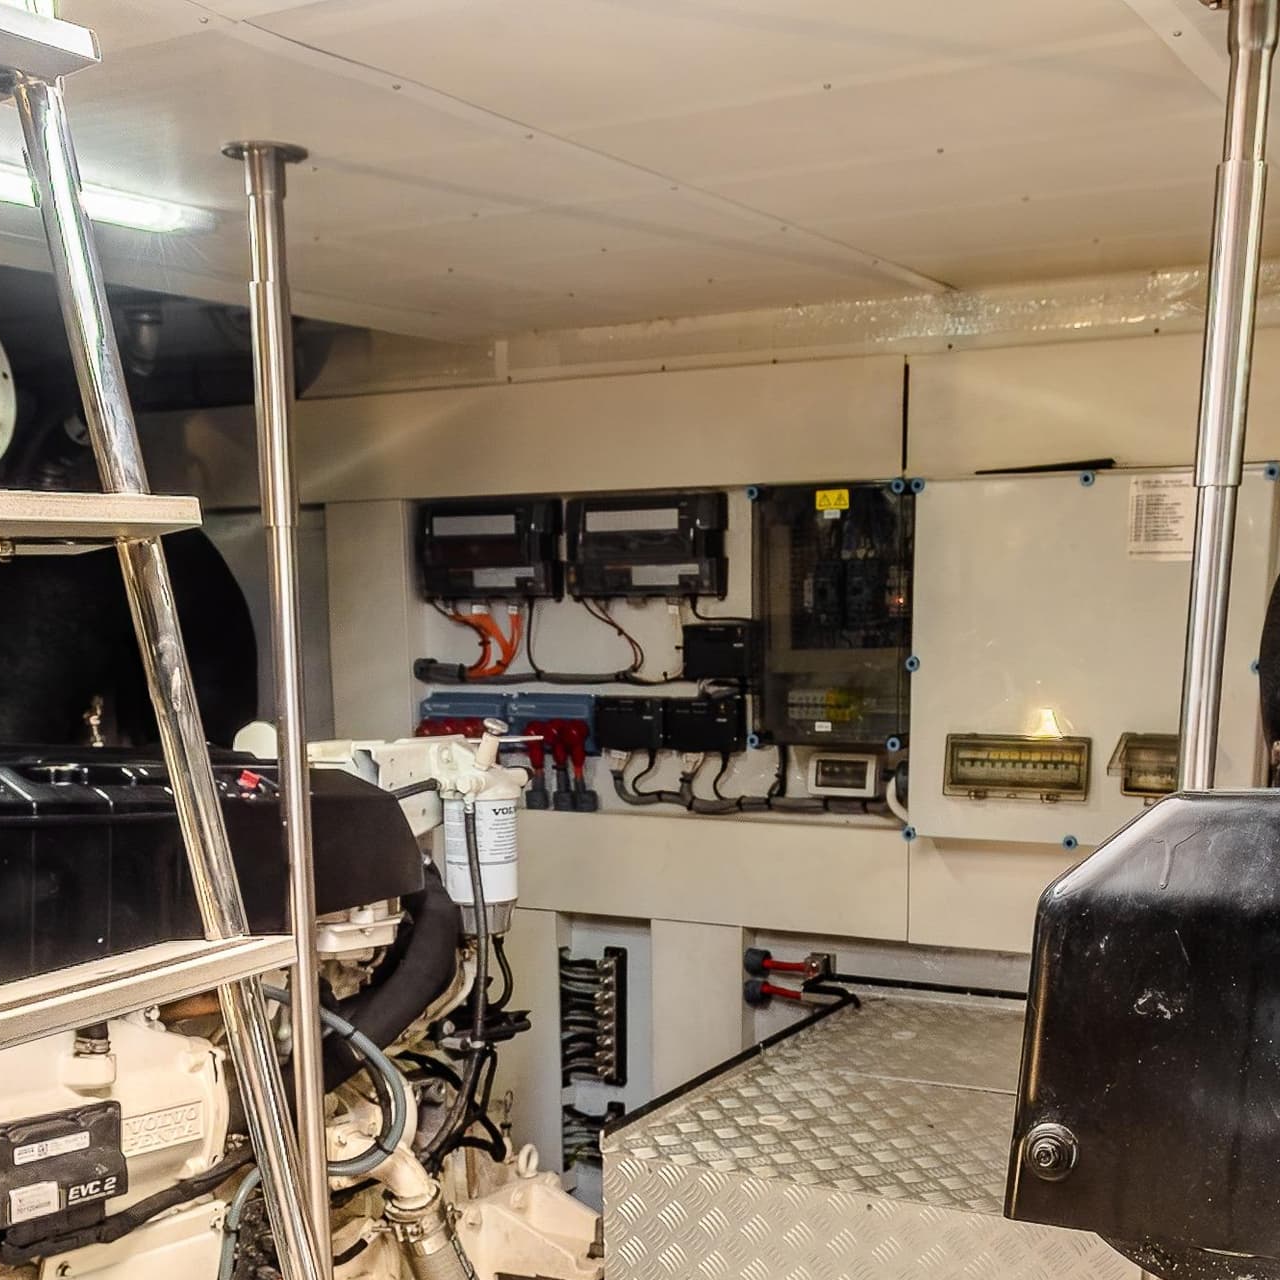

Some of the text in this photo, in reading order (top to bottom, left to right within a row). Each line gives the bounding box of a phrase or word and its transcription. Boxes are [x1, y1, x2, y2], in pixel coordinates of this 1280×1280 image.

[124, 1106, 198, 1135] VOLVO
[123, 1124, 201, 1153] PENTA
[67, 1180, 102, 1201] EVC
[103, 1176, 117, 1191] 2
